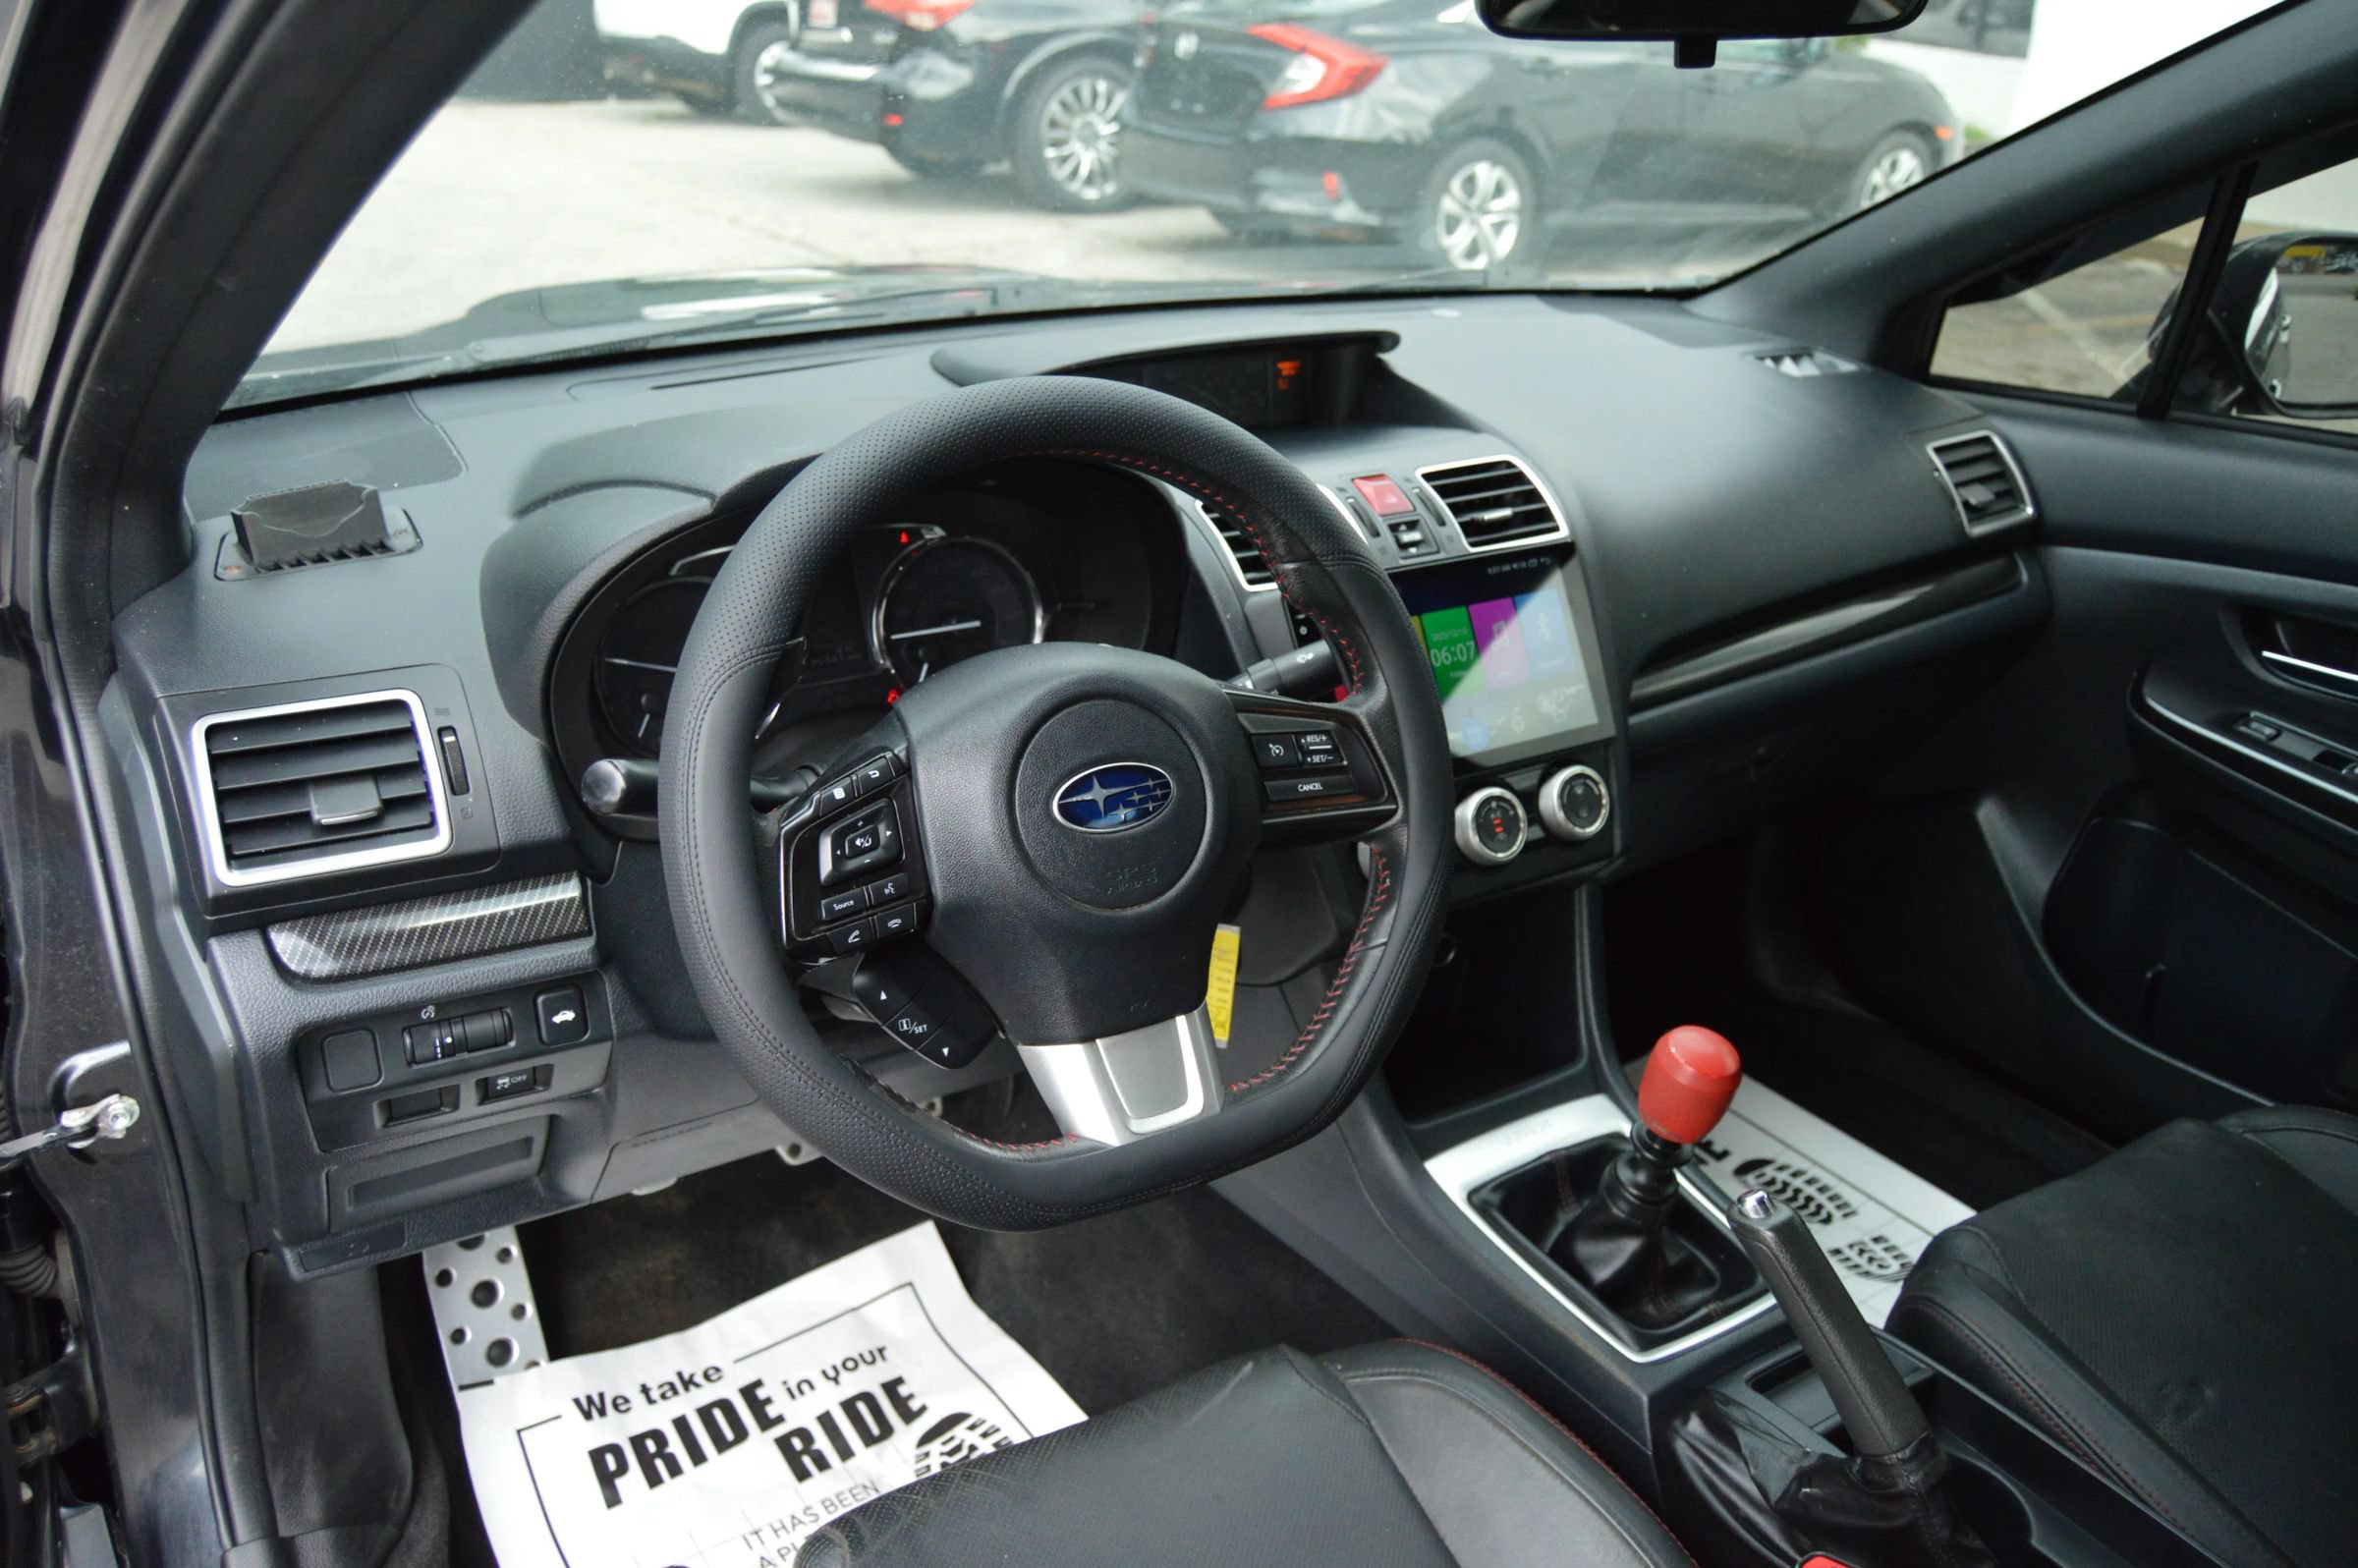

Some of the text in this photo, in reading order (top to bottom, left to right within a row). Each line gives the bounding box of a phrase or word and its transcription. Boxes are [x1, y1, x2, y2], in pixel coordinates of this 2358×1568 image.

[1431, 642, 1475, 667] 06:07
[1298, 782, 1323, 792] CANCEL
[833, 899, 855, 911] Source
[511, 1073, 528, 1084] OFF
[572, 1365, 724, 1423] We take
[587, 1345, 889, 1511] PRIDE in your
[773, 1375, 928, 1484] RIDE
[742, 1480, 881, 1551] IT HAS BEEN
